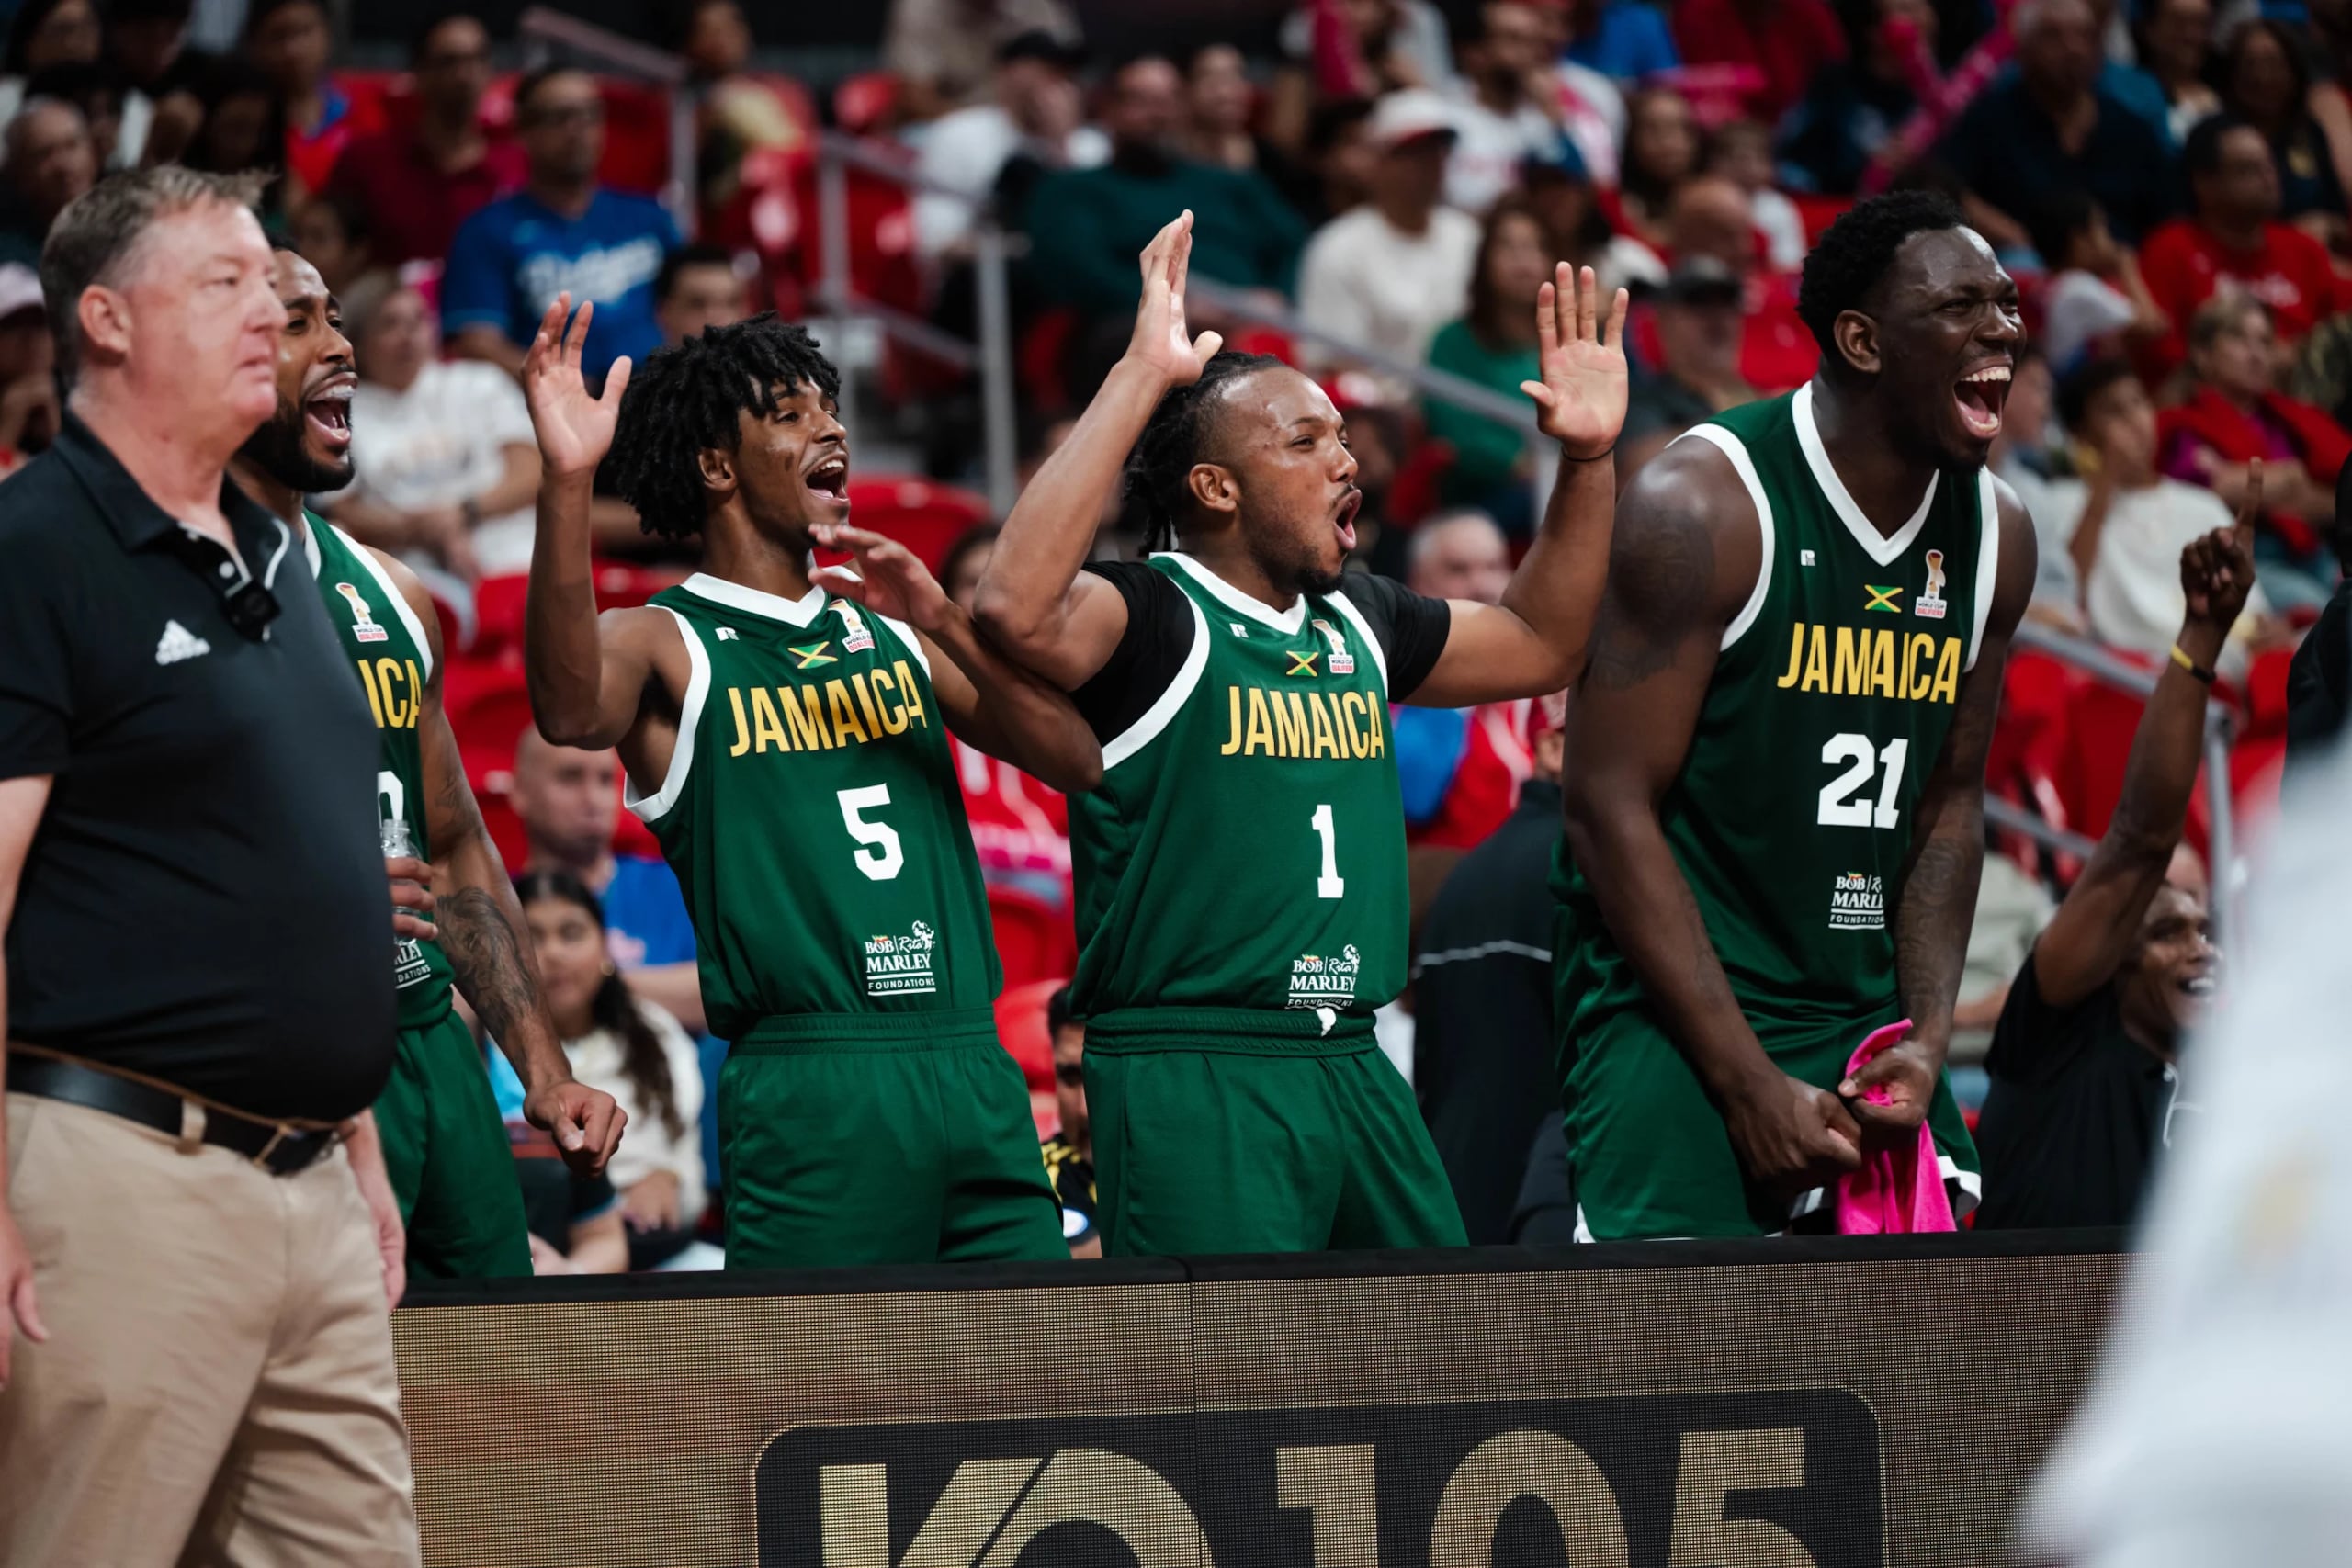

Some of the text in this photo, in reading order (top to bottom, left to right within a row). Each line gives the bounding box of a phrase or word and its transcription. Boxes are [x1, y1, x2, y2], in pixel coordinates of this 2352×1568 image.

[1777, 622, 1962, 705] JAMAICA
[728, 660, 928, 757] JAMAICA
[1221, 686, 1385, 759] JAMAICA
[1817, 733, 1909, 829] 21
[836, 783, 904, 881] 5
[1311, 805, 1344, 898] 1
[1836, 875, 1866, 890] BOB
[865, 936, 922, 954] BOB Rita
[865, 953, 931, 974] MARLEY
[1293, 958, 1352, 975] BOB Rita
[868, 977, 935, 990] FOUNDATIONS
[1288, 975, 1357, 992] MARLEY
